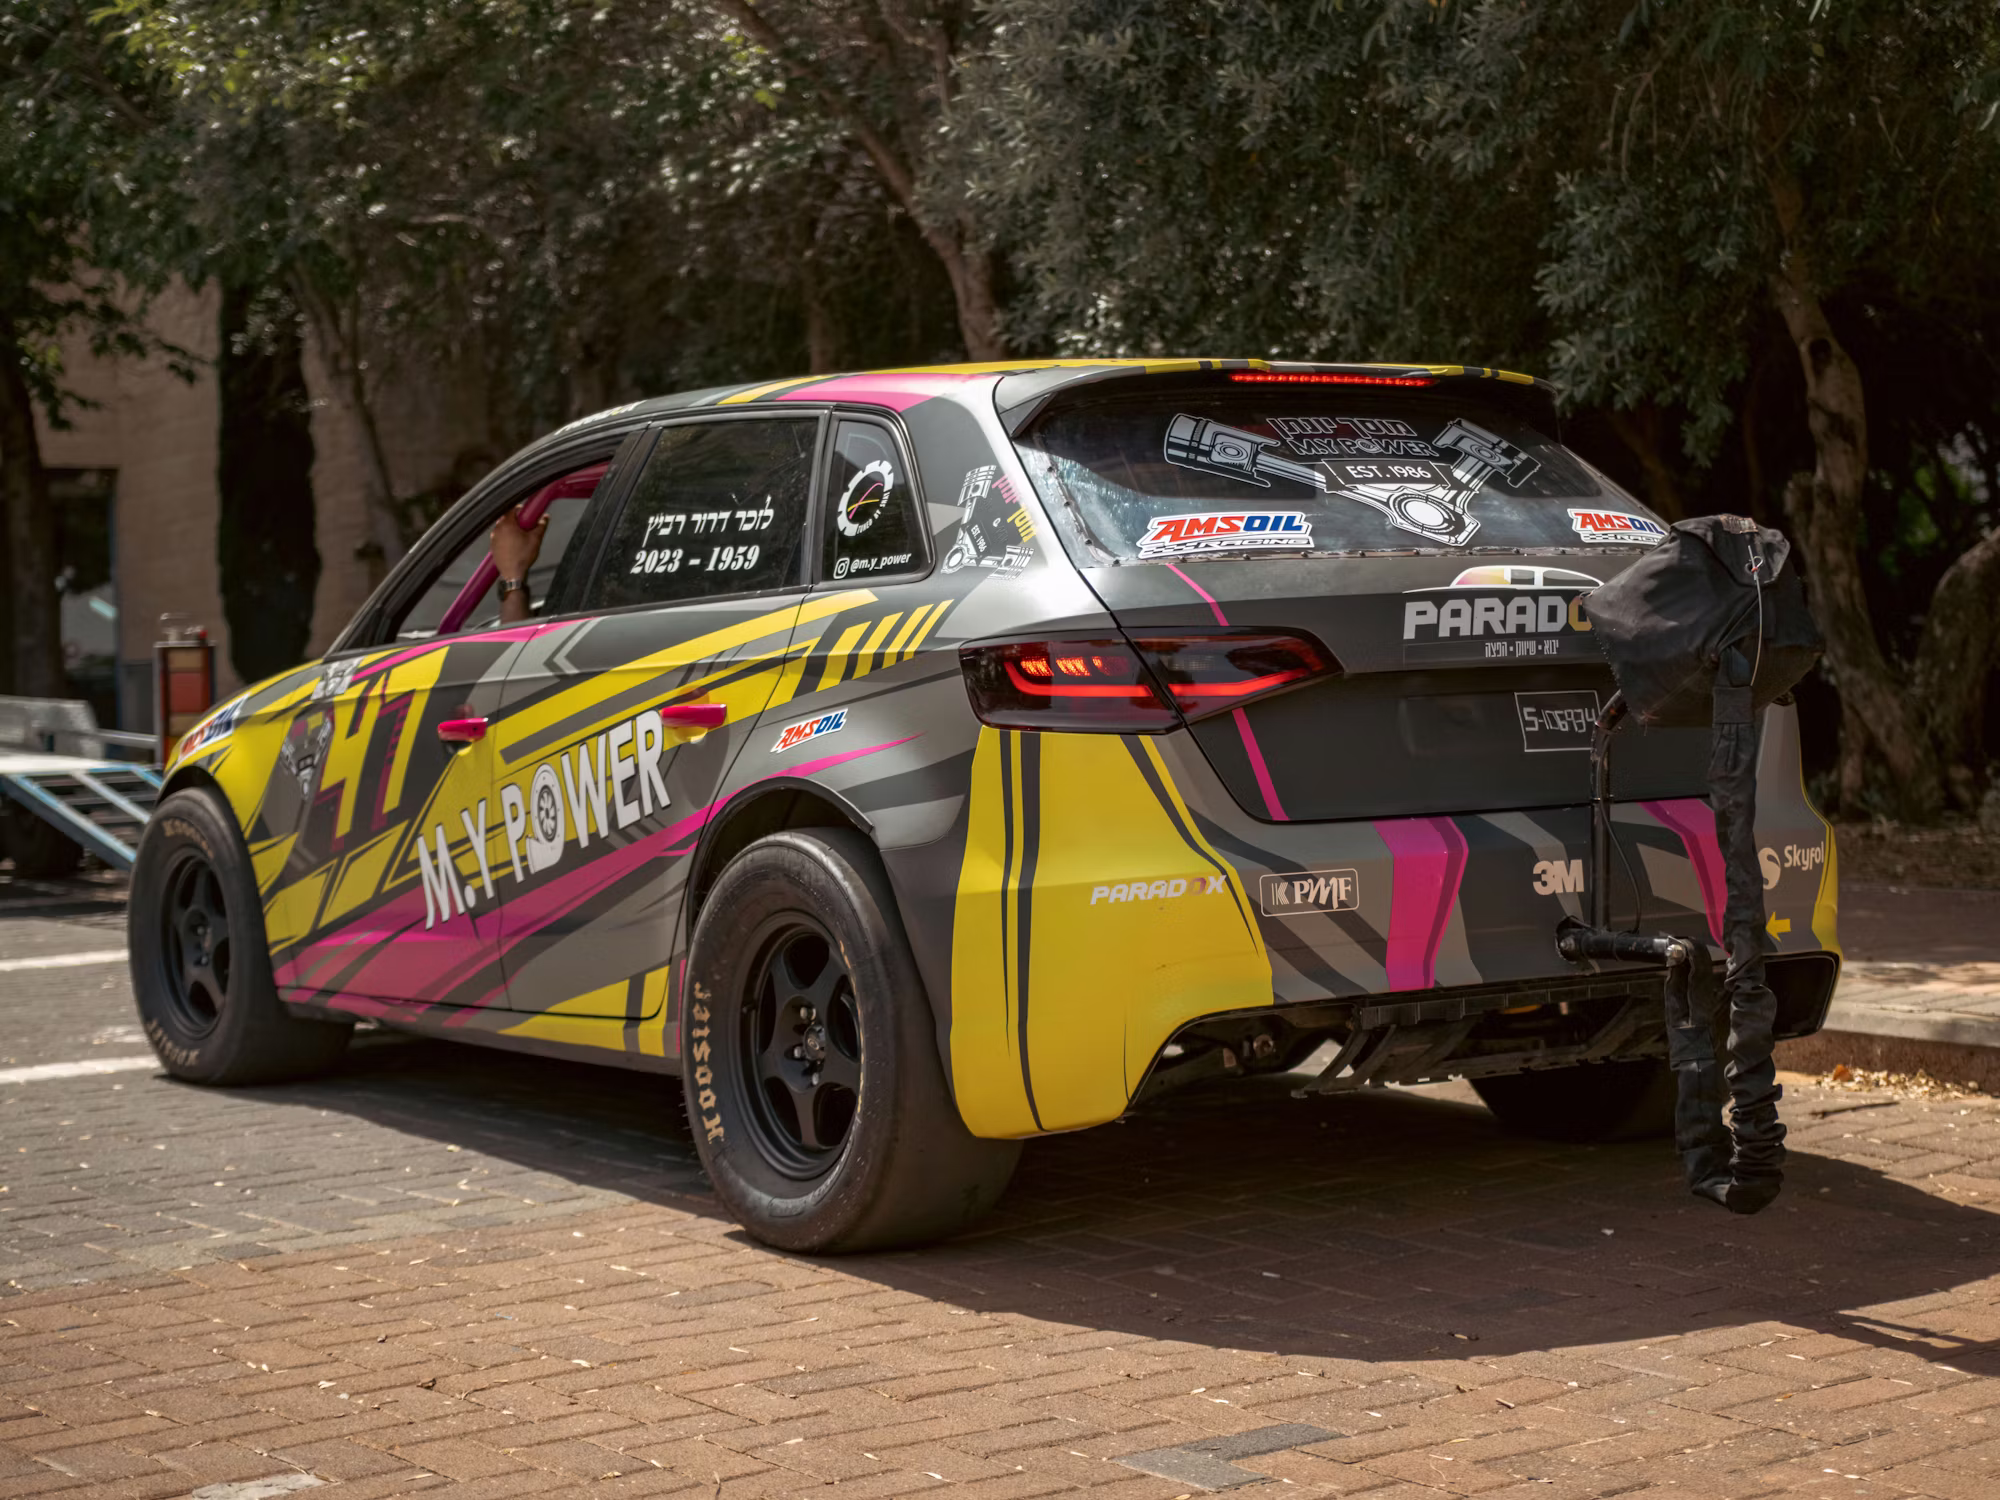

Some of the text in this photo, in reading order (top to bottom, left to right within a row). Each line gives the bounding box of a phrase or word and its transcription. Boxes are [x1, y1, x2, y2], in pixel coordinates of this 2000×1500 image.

[1266, 417, 1417, 440] מוסך יונתן
[1337, 438, 1439, 457] POWER
[1390, 465, 1432, 479] 1986
[690, 509, 733, 534] דרור
[735, 494, 774, 532] לזכר
[1574, 512, 1665, 536] AMSOIL
[1151, 515, 1303, 543] AMSOIL
[1199, 538, 1311, 549] RACING
[629, 548, 684, 574] 2023
[704, 545, 760, 572] 1959
[850, 553, 912, 573] @m.y_power
[1403, 595, 1593, 640] PARADO
[1485, 639, 1559, 658] יבוא שיווק הפצה
[775, 711, 845, 749] AMSOIL
[417, 710, 672, 931] M.Y POWER
[1783, 841, 1825, 871] Skyfol
[1090, 874, 1227, 906] PARADOX
[1532, 859, 1585, 896] 3M
